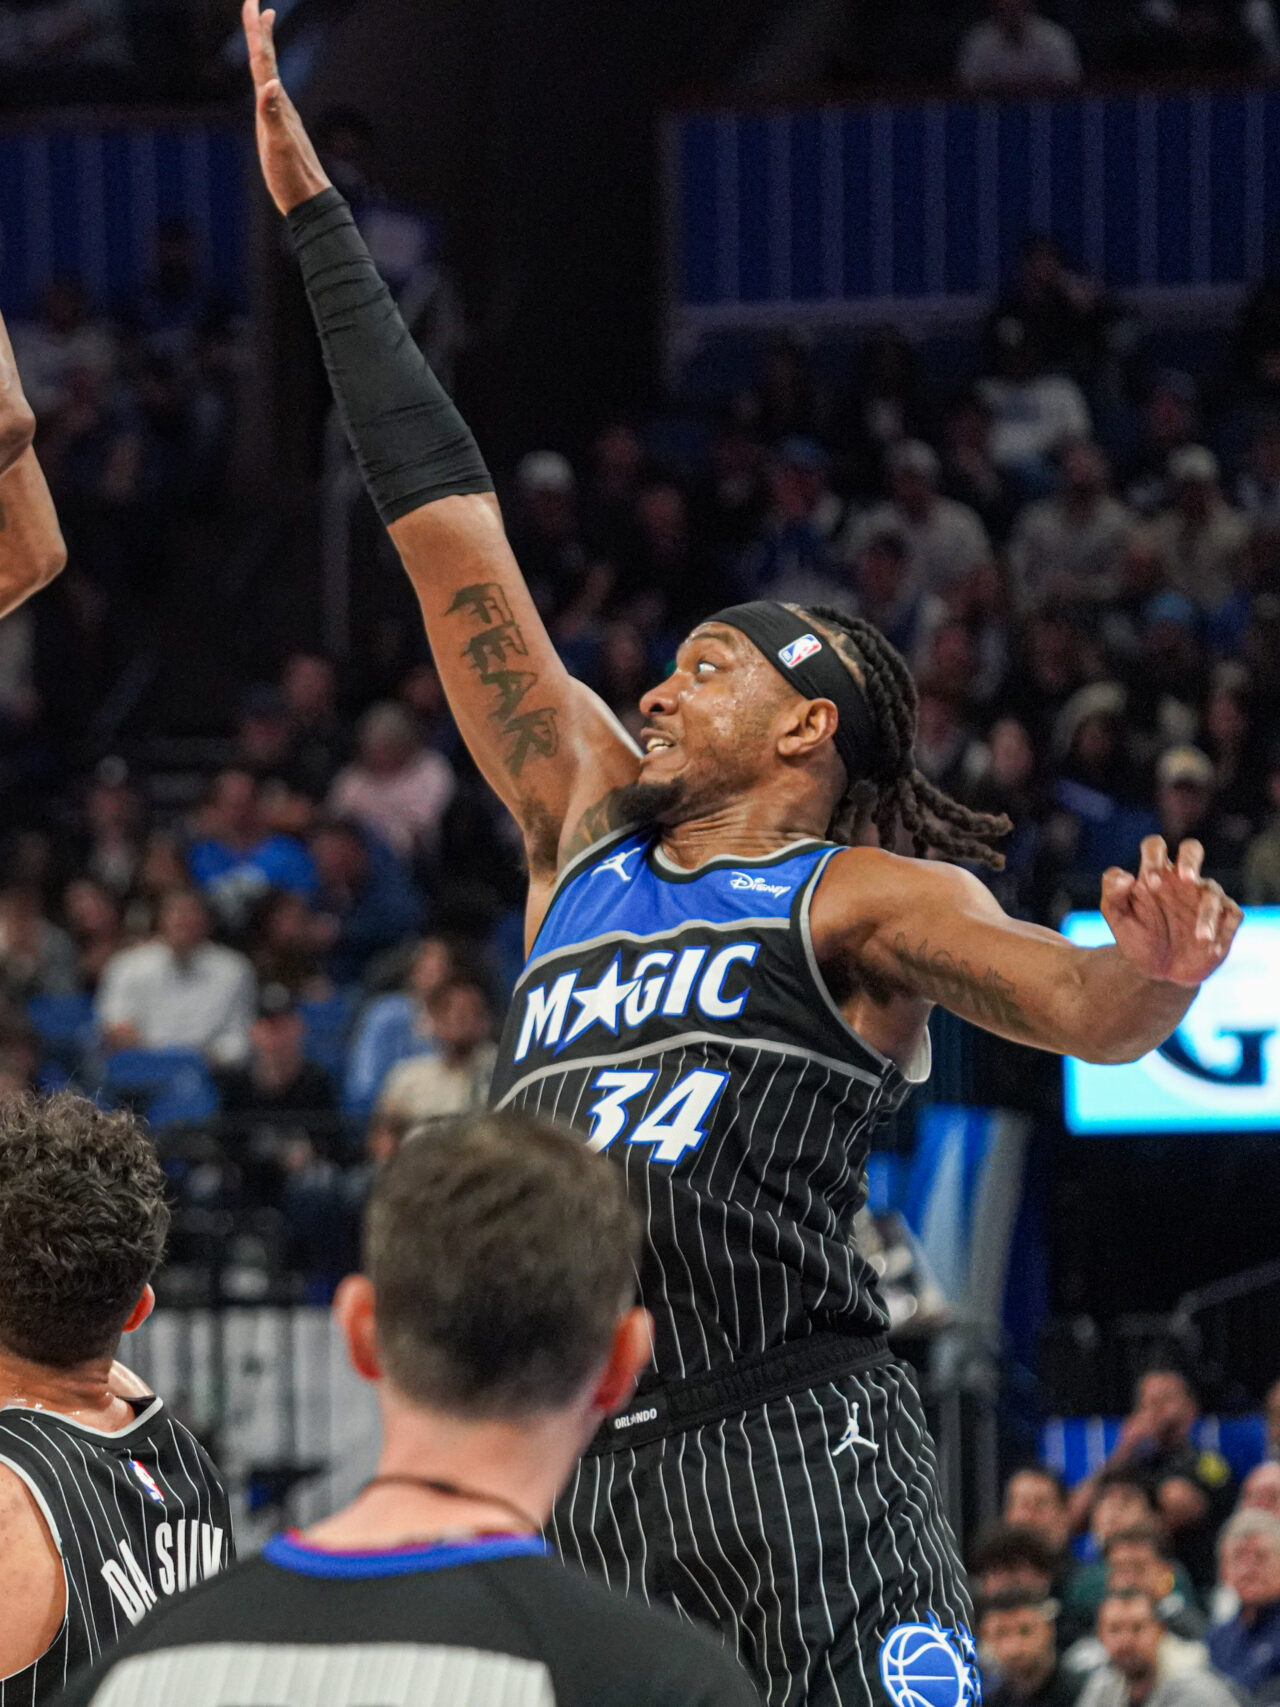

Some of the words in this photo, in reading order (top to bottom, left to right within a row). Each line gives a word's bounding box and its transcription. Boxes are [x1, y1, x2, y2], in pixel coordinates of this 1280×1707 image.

[444, 582, 560, 778] FEAR
[586, 1066, 731, 1165] 34
[100, 1538, 158, 1627] DA
